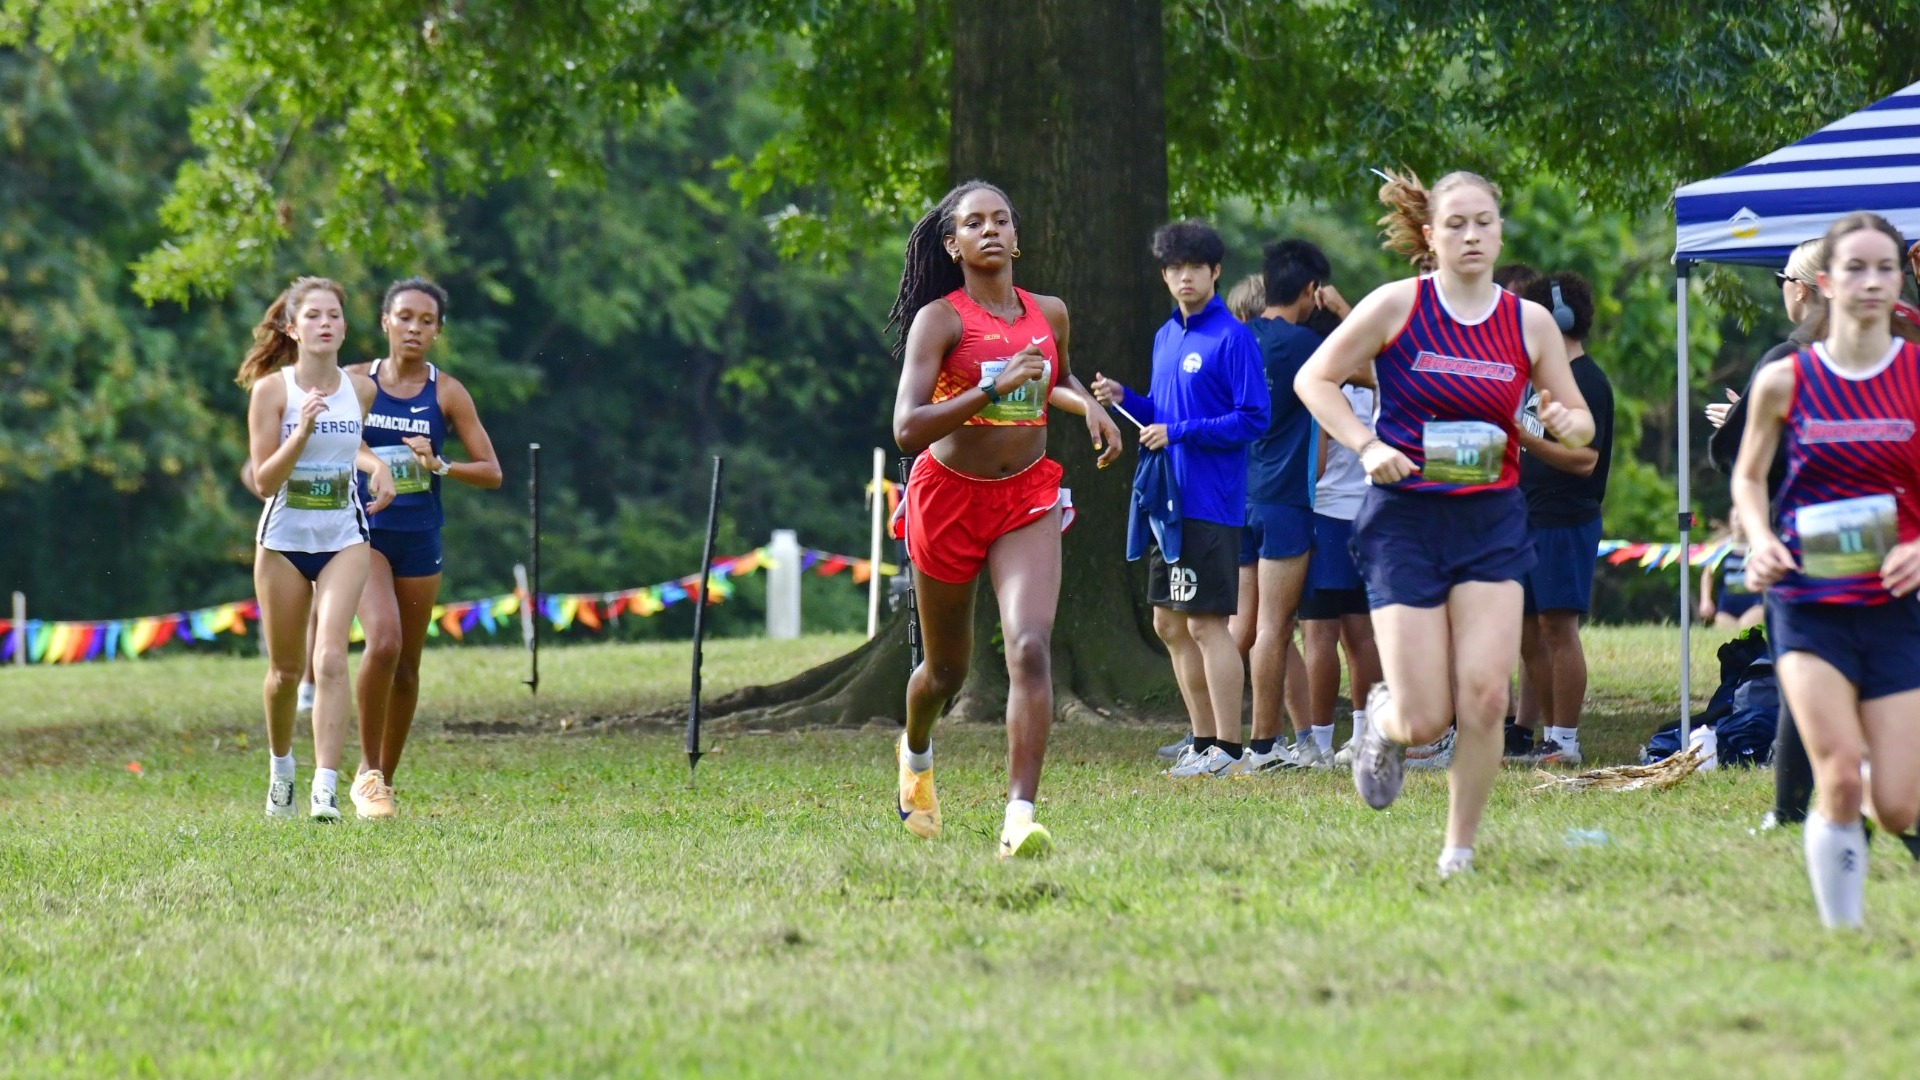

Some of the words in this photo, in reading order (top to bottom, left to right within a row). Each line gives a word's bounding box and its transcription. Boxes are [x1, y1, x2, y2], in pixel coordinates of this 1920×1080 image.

[286, 420, 361, 438] JFERSON
[1456, 448, 1479, 467] 10
[310, 482, 331, 496] 59
[1839, 529, 1863, 553] 11
